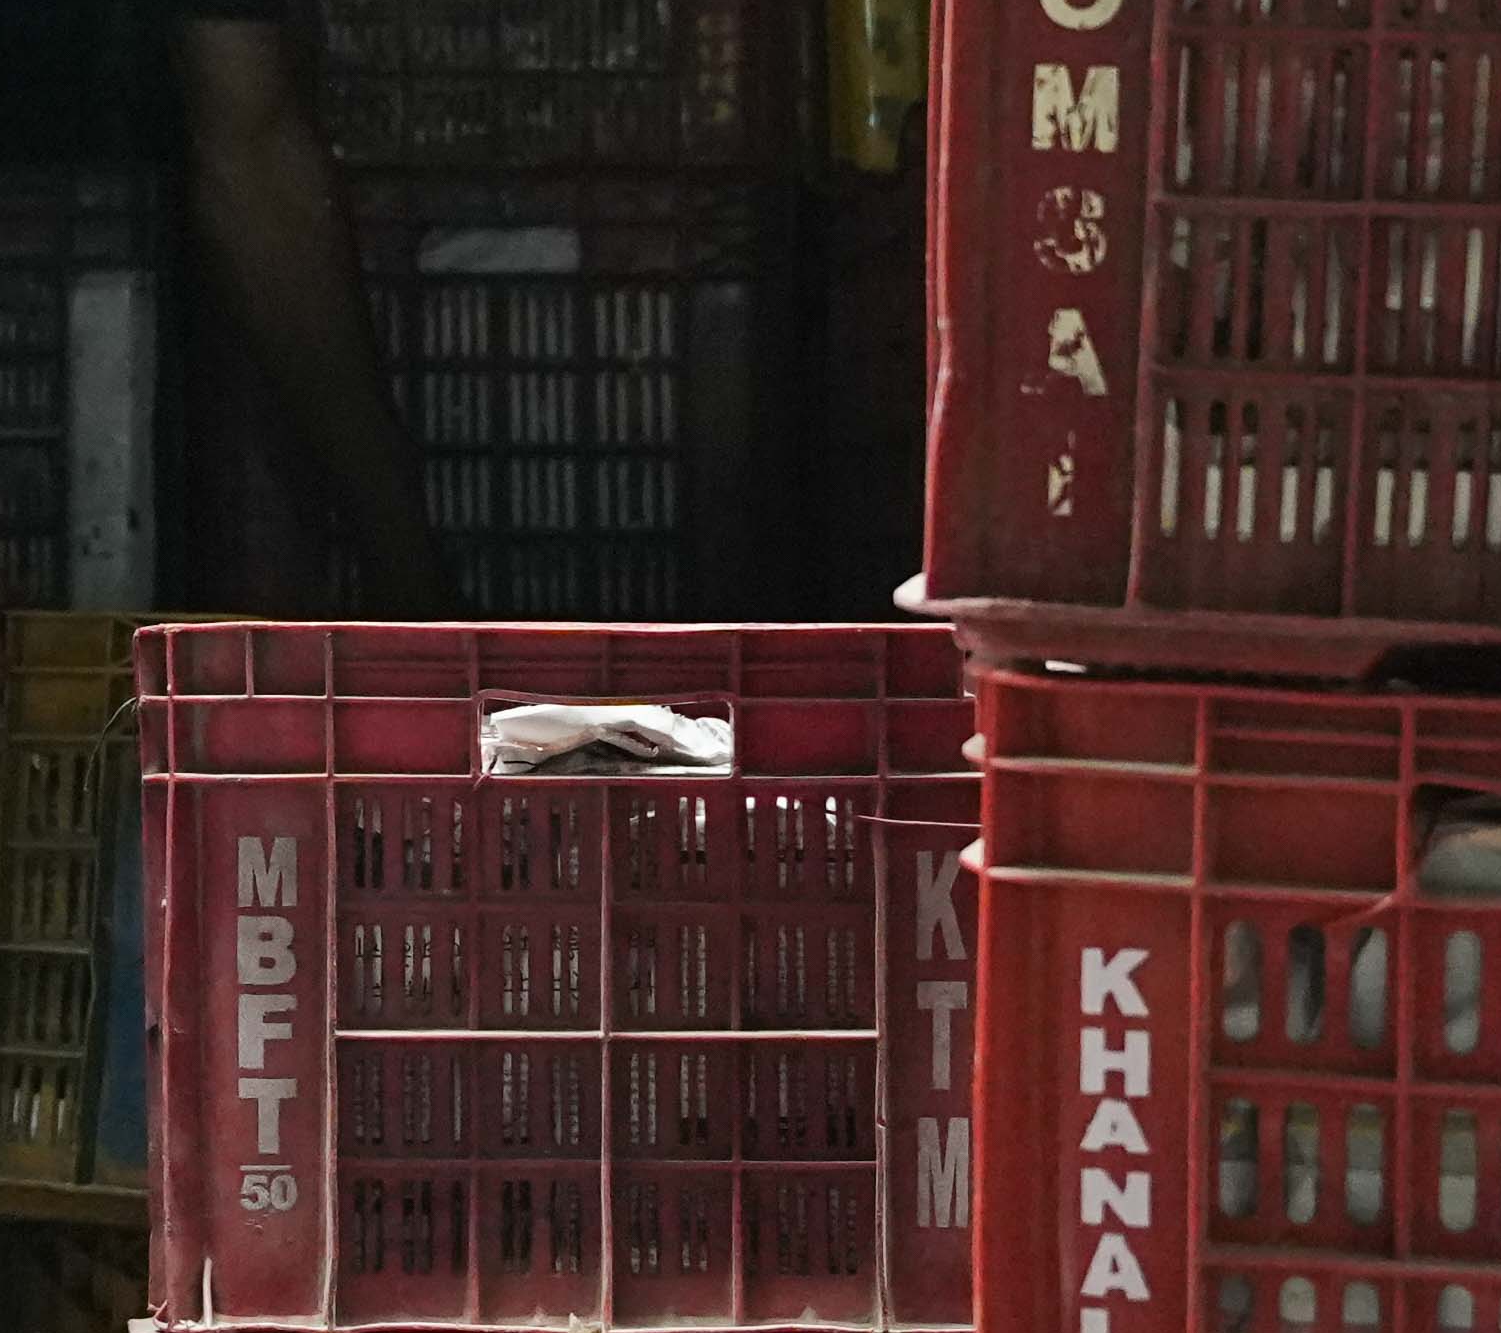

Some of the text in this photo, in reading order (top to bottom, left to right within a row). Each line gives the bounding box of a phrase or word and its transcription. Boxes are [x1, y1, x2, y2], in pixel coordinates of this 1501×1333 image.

[237, 836, 297, 1155] MBFT
[916, 851, 970, 1228] KTM
[240, 1174, 297, 1212] 50
